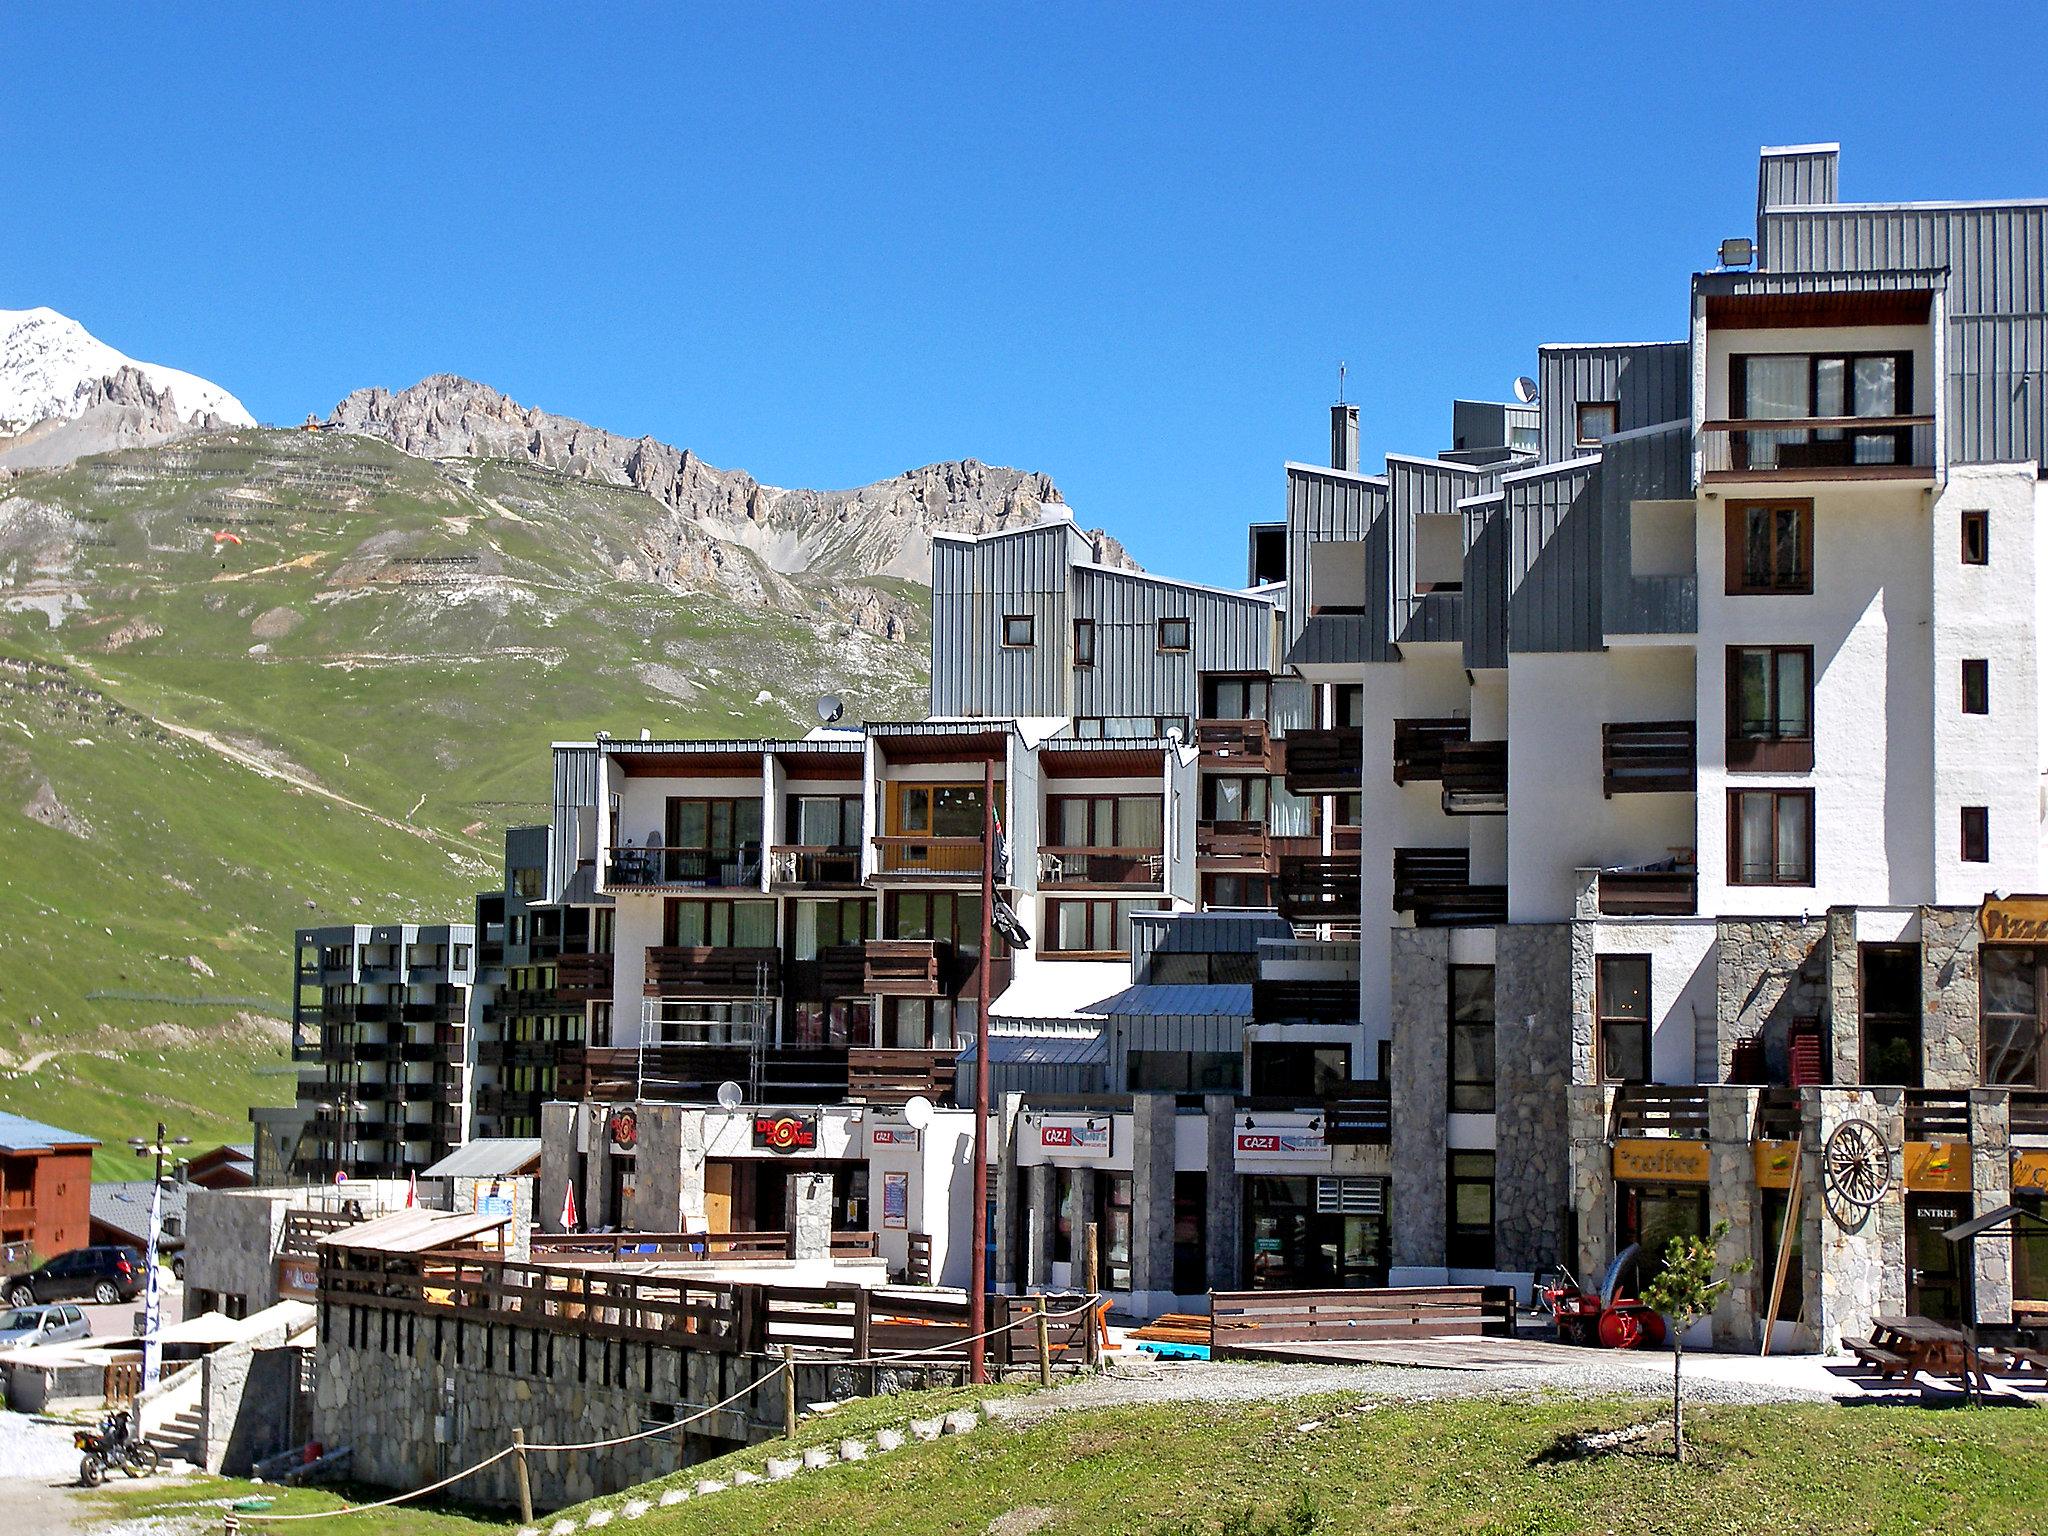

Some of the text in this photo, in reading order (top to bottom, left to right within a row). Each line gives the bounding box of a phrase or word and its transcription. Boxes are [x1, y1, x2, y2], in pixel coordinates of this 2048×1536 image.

[766, 1130, 813, 1146] ZONE
[1045, 1130, 1068, 1143] CAZ!
[1243, 1136, 1274, 1148] CAZ!
[1917, 1208, 1957, 1218] ENTREE
